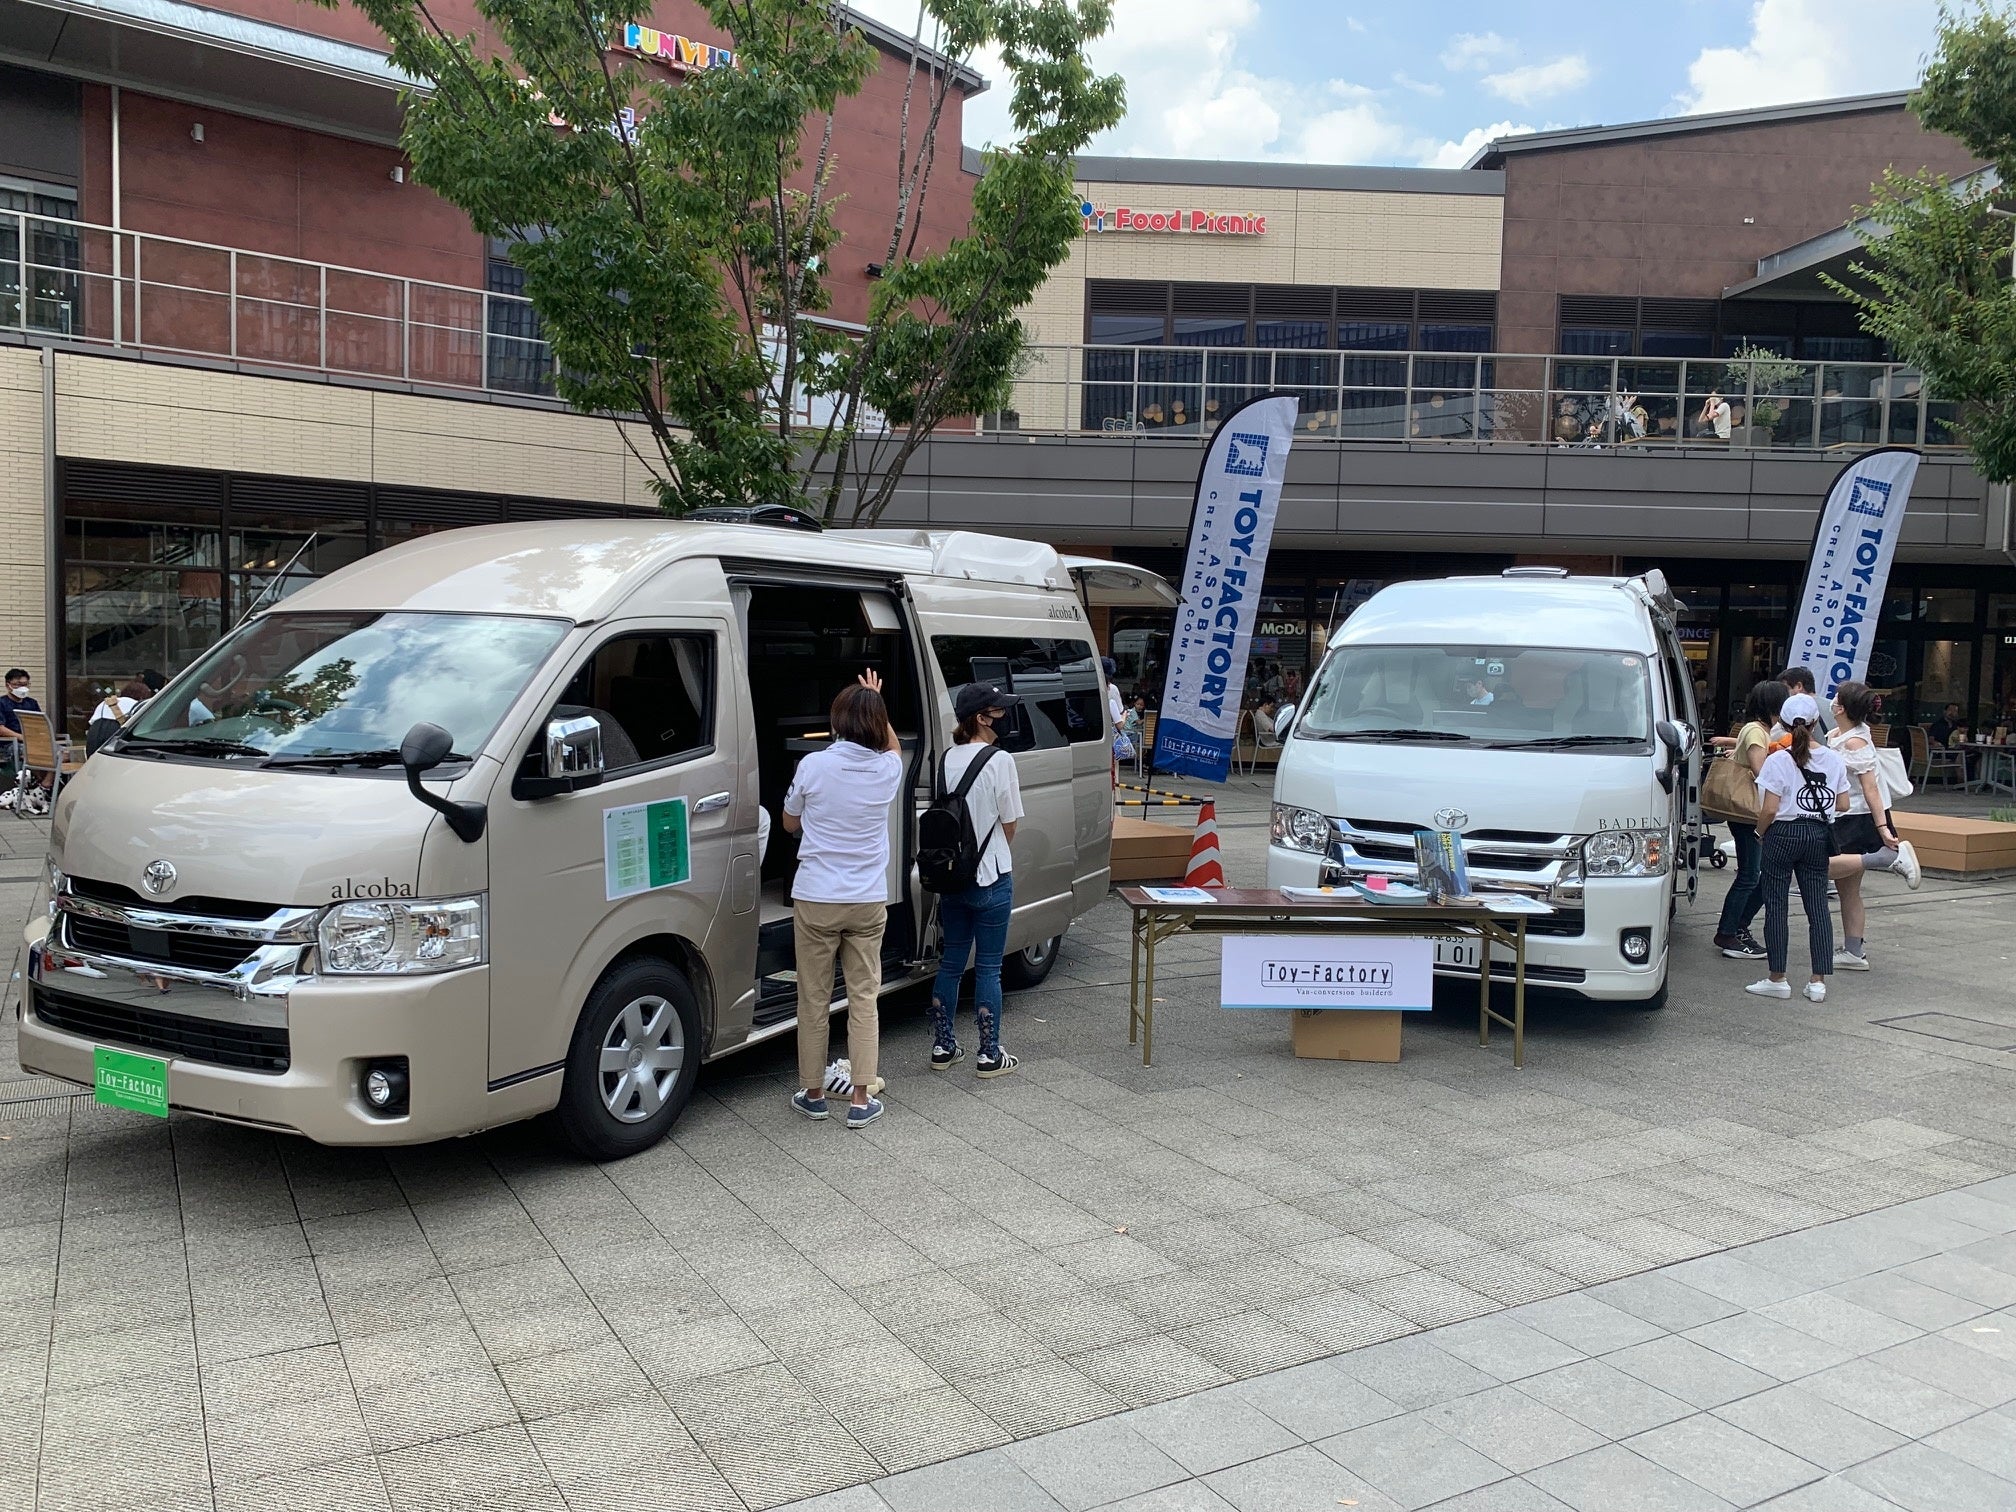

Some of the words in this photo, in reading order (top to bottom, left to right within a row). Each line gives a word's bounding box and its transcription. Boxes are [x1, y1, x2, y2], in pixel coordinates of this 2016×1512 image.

[1114, 208, 1182, 231] Food
[1190, 210, 1267, 234] Picnic
[1191, 490, 1217, 594] CREATING
[1812, 525, 1840, 614] CREATING
[1194, 554, 1221, 645] ASOBI
[1199, 489, 1263, 718] TOY-FACTORY
[1260, 622, 1306, 635] McDo
[1816, 580, 1843, 660] ASOBI
[1171, 608, 1195, 703] COMPANY
[1801, 626, 1816, 662] COM
[1599, 817, 1662, 829] BADEN
[331, 877, 412, 898] alcoba
[1268, 963, 1389, 984] Toy-Factory
[101, 1070, 162, 1098] Toy-Factory
